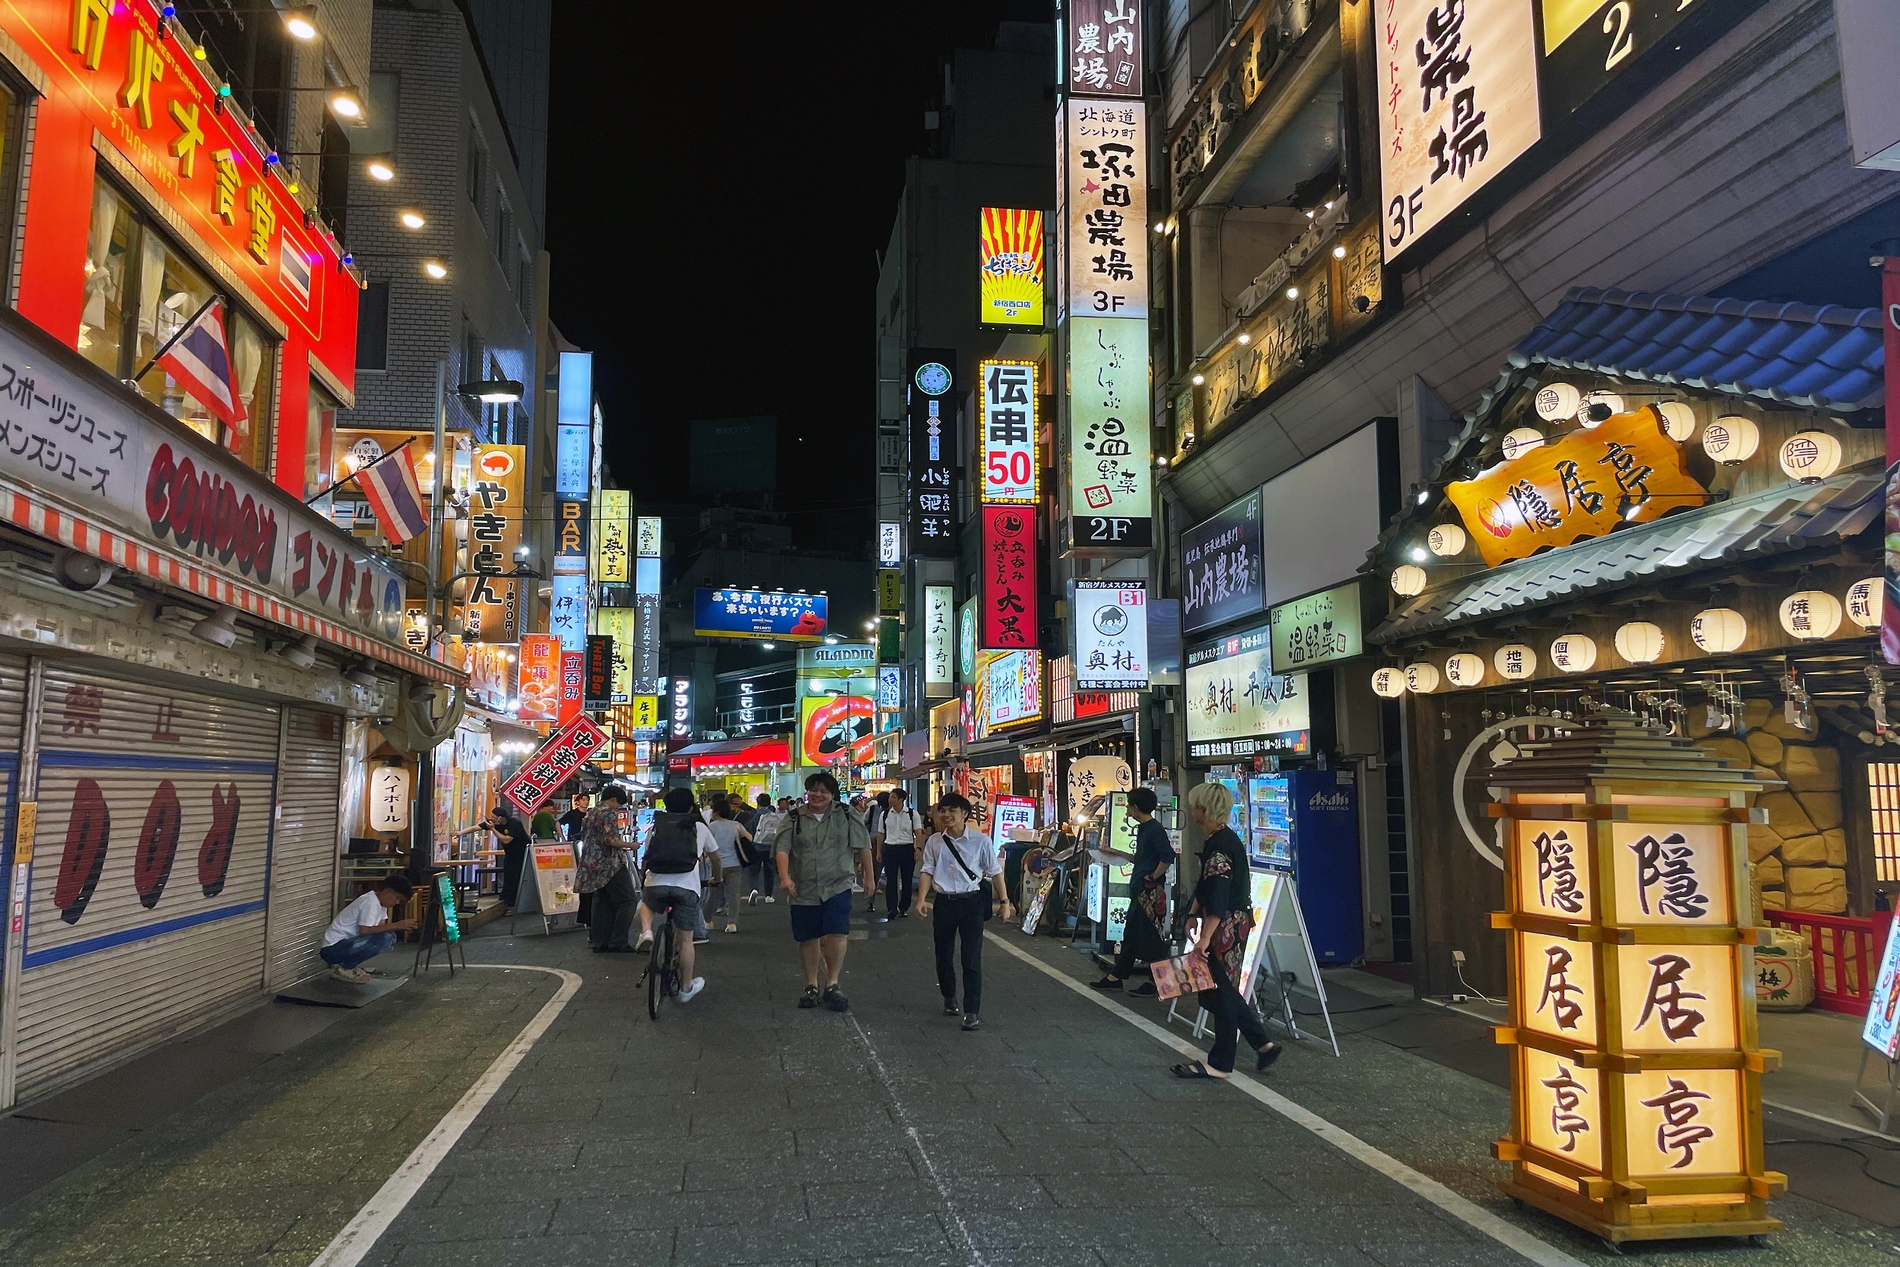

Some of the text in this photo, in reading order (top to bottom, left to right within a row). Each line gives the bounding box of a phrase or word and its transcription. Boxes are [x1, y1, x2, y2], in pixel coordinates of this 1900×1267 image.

[133, 8, 202, 103] FOOD RESTAURANT
[1079, 107, 1136, 125] 北海道
[1080, 126, 1136, 140] シントク町
[1388, 185, 1424, 248] 3F
[1006, 309, 1018, 317] 2F
[1093, 291, 1125, 312] 3F
[0, 364, 128, 460] スポーツシューズ
[988, 367, 1029, 445] 伝串
[0, 420, 110, 497] メンズシューズ
[987, 451, 1031, 485] 50
[1084, 417, 1138, 495] 温野菜
[1004, 486, 1014, 495] 円
[1246, 499, 1256, 520] 4F
[562, 503, 582, 552] BAR
[883, 527, 894, 559] 石狩川
[1090, 517, 1132, 541] 2F
[1010, 540, 1026, 582] 立呑み
[1185, 544, 1249, 614] 山内農場
[554, 596, 573, 629] 伊吹
[712, 591, 813, 607] あ、今夜、夜行バスで
[1121, 591, 1143, 605] B1
[1850, 584, 1870, 617] 馬刺
[997, 587, 1026, 643] 大黒
[1272, 609, 1282, 624] 2F
[1789, 599, 1810, 631] 焼鳥
[815, 649, 875, 661] ALADDIN
[1289, 617, 1336, 663] 温野菜
[1554, 641, 1571, 668] 個室
[1085, 650, 1135, 671] 奥村
[1506, 649, 1523, 675] 地酒
[565, 656, 579, 700] 立呑み
[1408, 667, 1419, 690] アサヒ
[1205, 678, 1234, 715] 奥村
[639, 701, 650, 725] 庄屋
[513, 729, 595, 807] 中華料理
[383, 775, 401, 823] ハイボール
[1309, 790, 1349, 805] Asahi
[1002, 809, 1029, 822] 伝串
[1531, 829, 1591, 1153] 隠居亭
[1758, 967, 1782, 987] 梅
[1627, 833, 1713, 1169] 隠居亭
